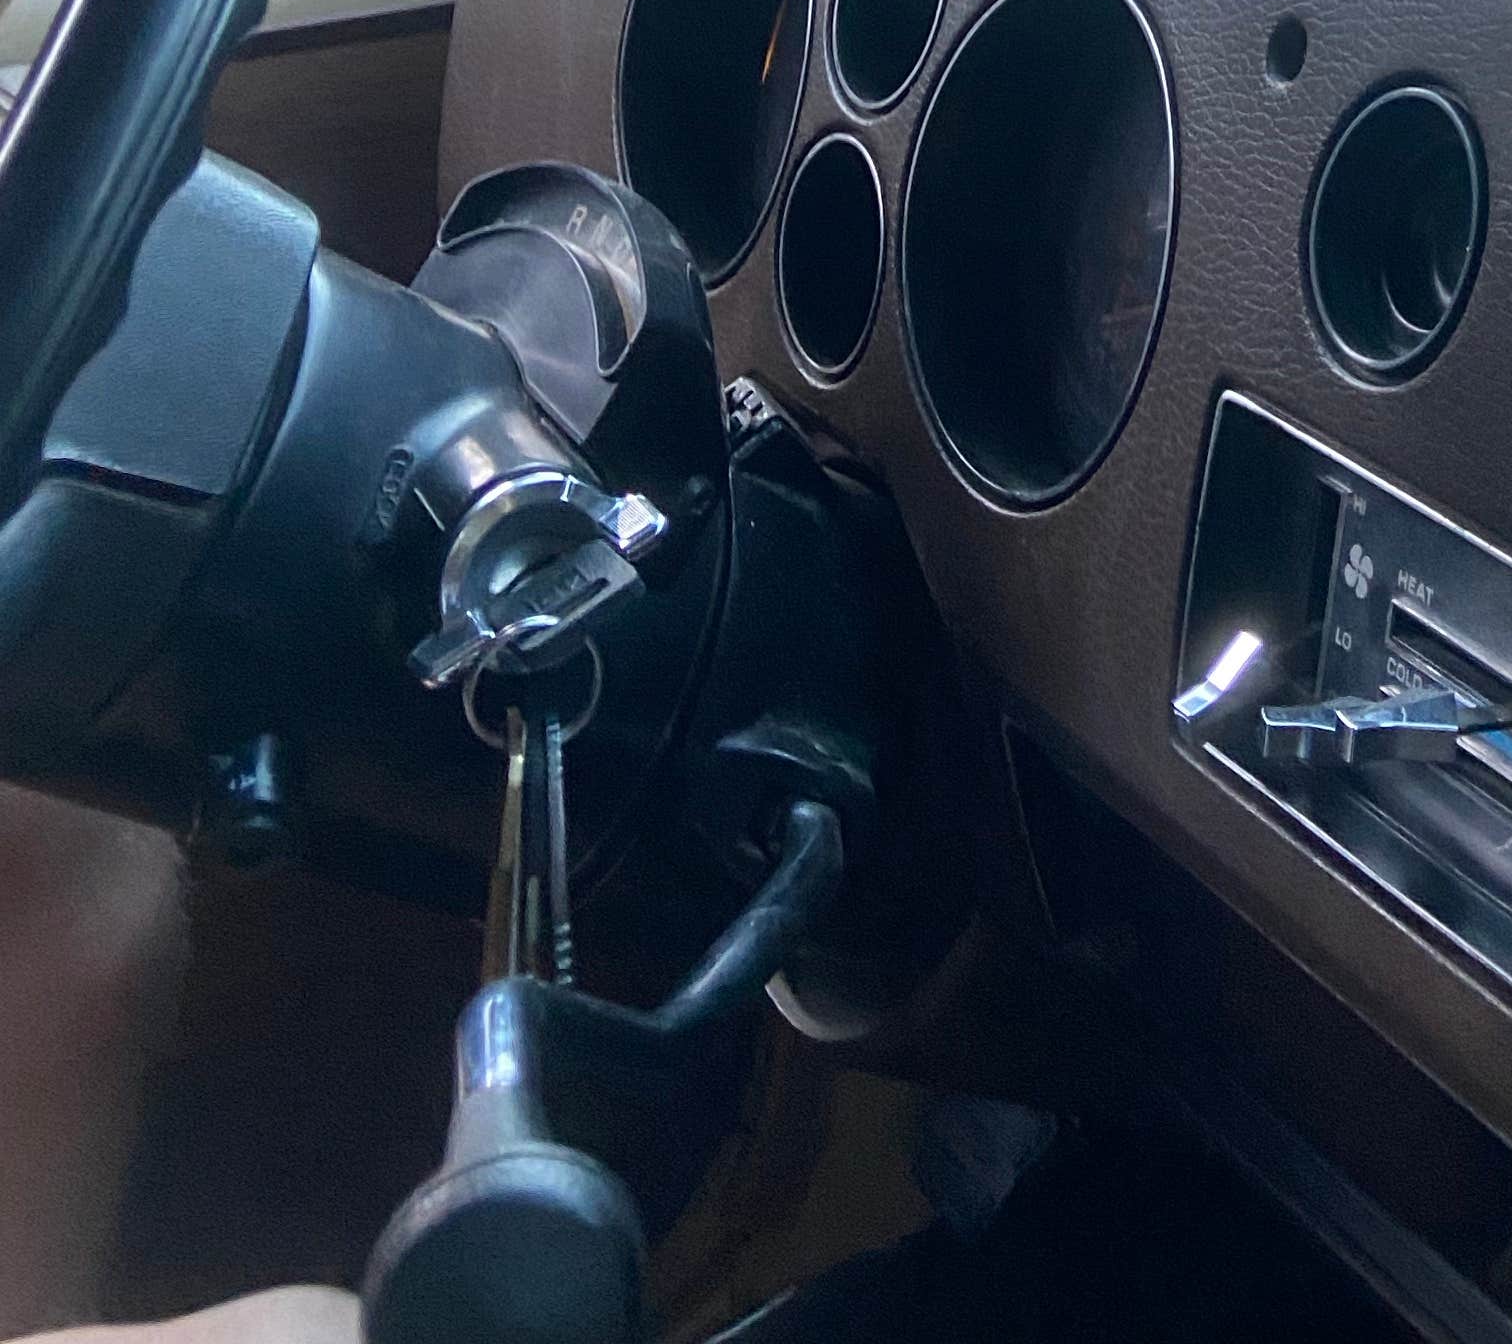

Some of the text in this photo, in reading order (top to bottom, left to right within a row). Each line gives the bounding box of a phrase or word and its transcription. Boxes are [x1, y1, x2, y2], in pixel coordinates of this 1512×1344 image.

[566, 204, 588, 236] R
[1353, 494, 1367, 516] HI
[1397, 568, 1434, 607] HEAT
[1335, 627, 1352, 650] LO
[1386, 656, 1423, 689] COLD
